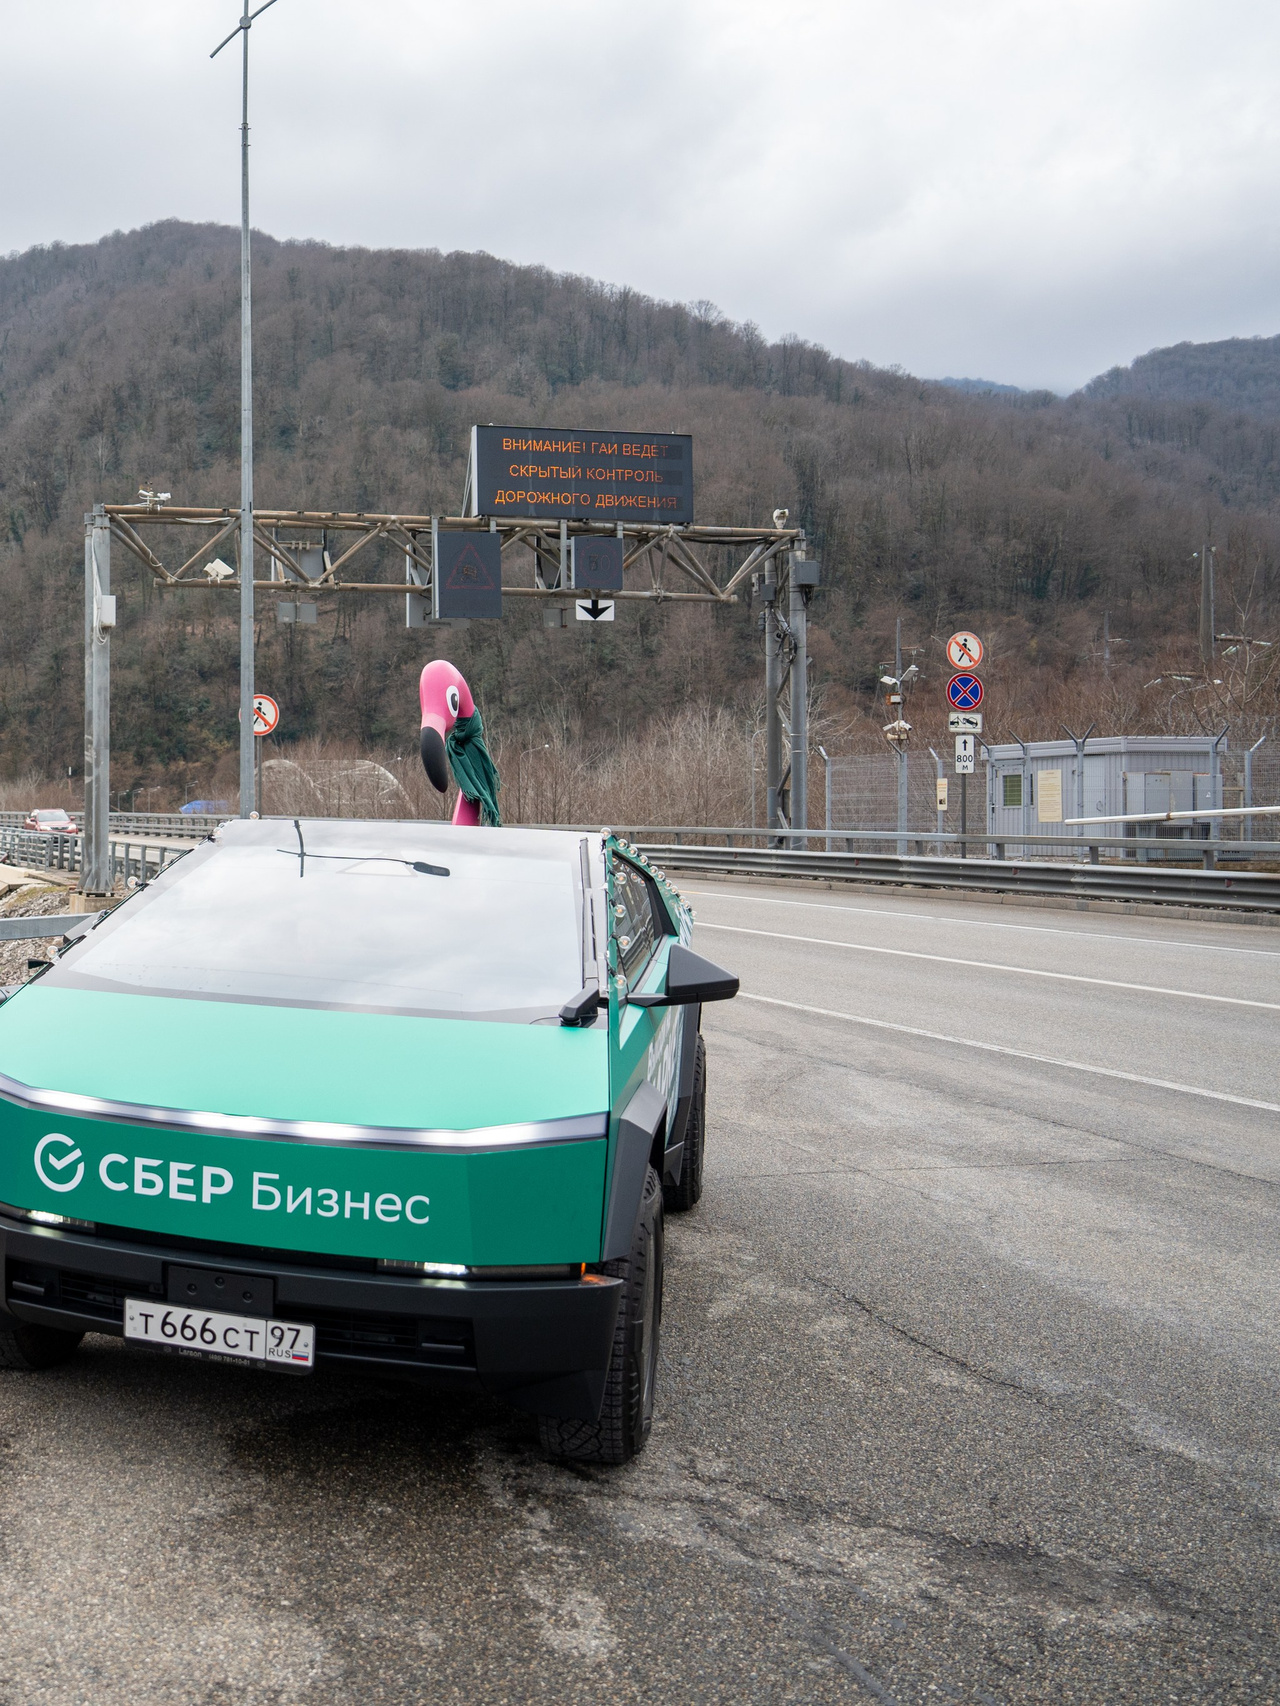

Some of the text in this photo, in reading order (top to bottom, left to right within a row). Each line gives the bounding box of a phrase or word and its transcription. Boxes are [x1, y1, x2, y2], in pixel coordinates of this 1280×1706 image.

[502, 438, 668, 459] ВНИМАНИЕ! ГАИ ВЕДЕТ
[509, 464, 663, 483] СКРЫТЫЙ КОНТРОЛЬ
[495, 490, 677, 509] ДОРОЖНОГО ДВИЖЕНИЯ
[956, 754, 974, 763] 800
[98, 1152, 430, 1225] СБЕР Бизнес
[270, 1326, 301, 1350] 97
[178, 1347, 203, 1359] Larson
[269, 1347, 292, 1359] RUS
